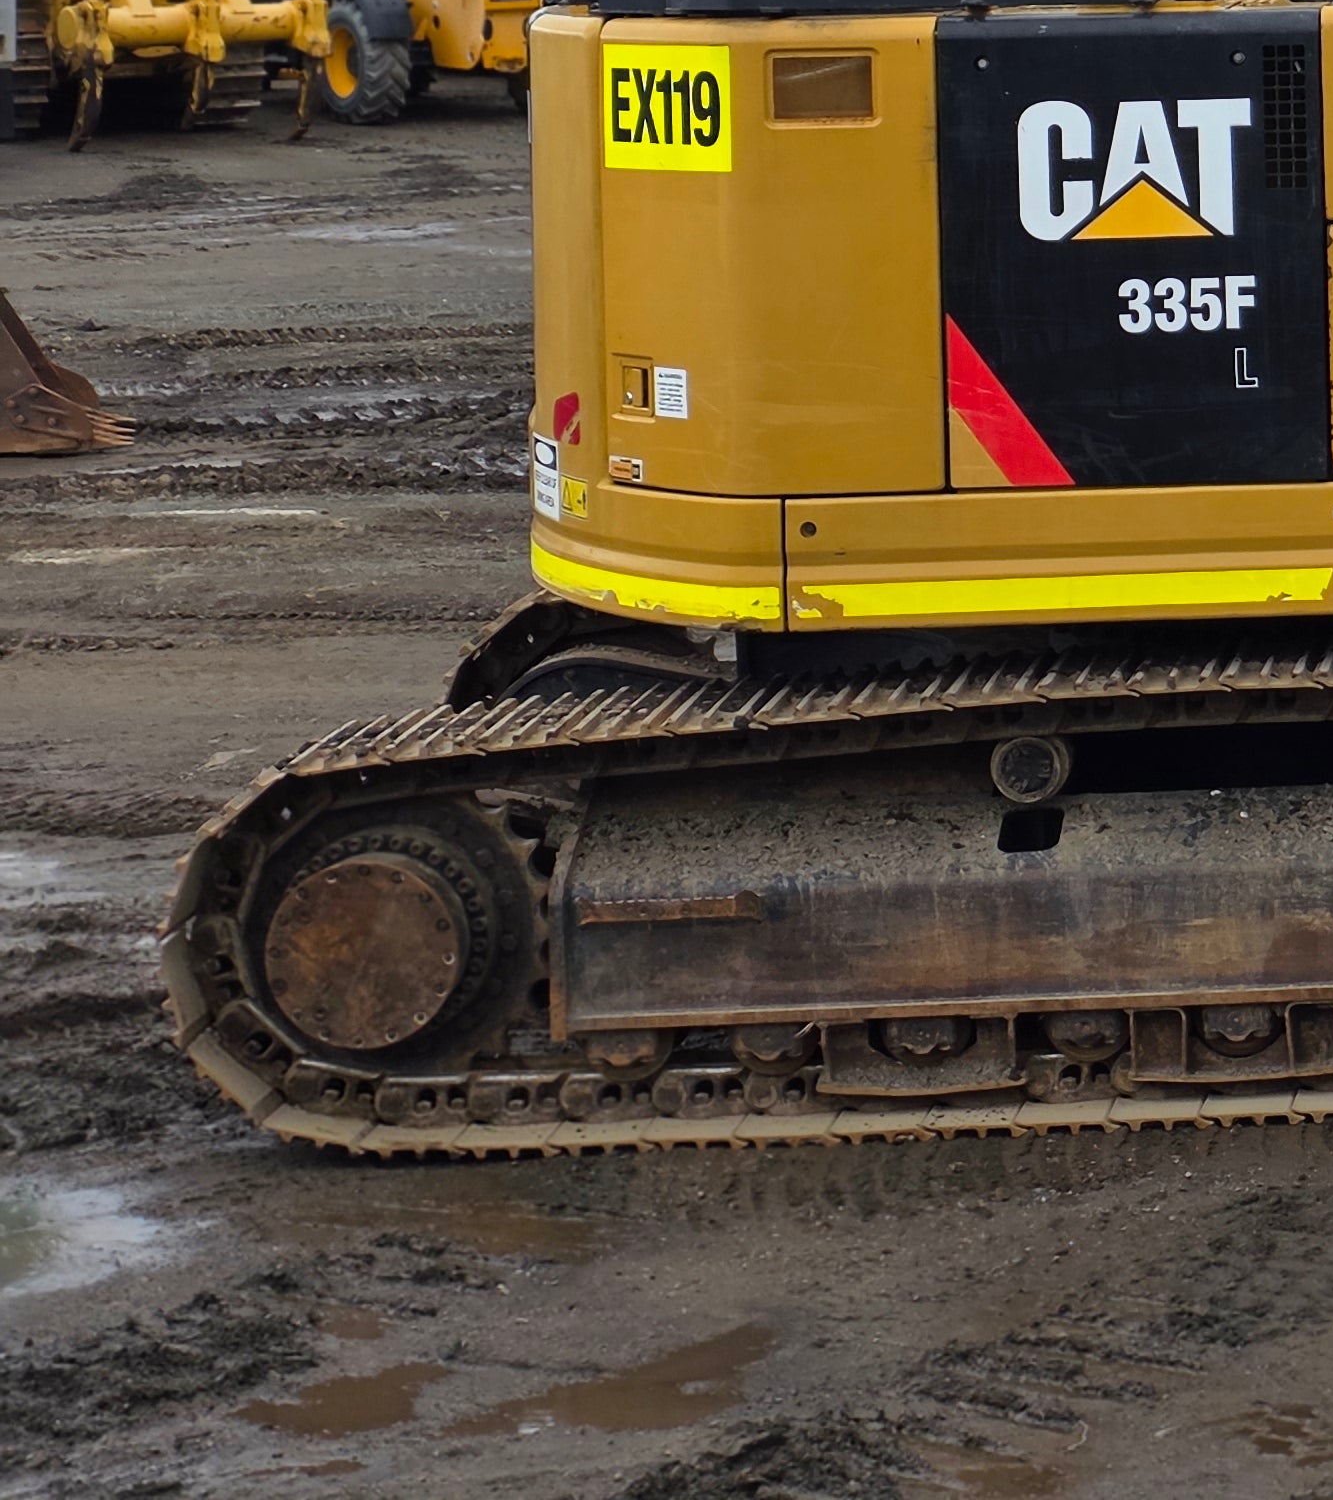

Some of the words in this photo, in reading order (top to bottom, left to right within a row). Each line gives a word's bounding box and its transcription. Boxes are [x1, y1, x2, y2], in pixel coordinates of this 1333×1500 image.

[611, 68, 721, 147] EX119
[1017, 98, 1251, 241] CAT
[1118, 275, 1255, 333] 335F
[1234, 347, 1258, 388] L
